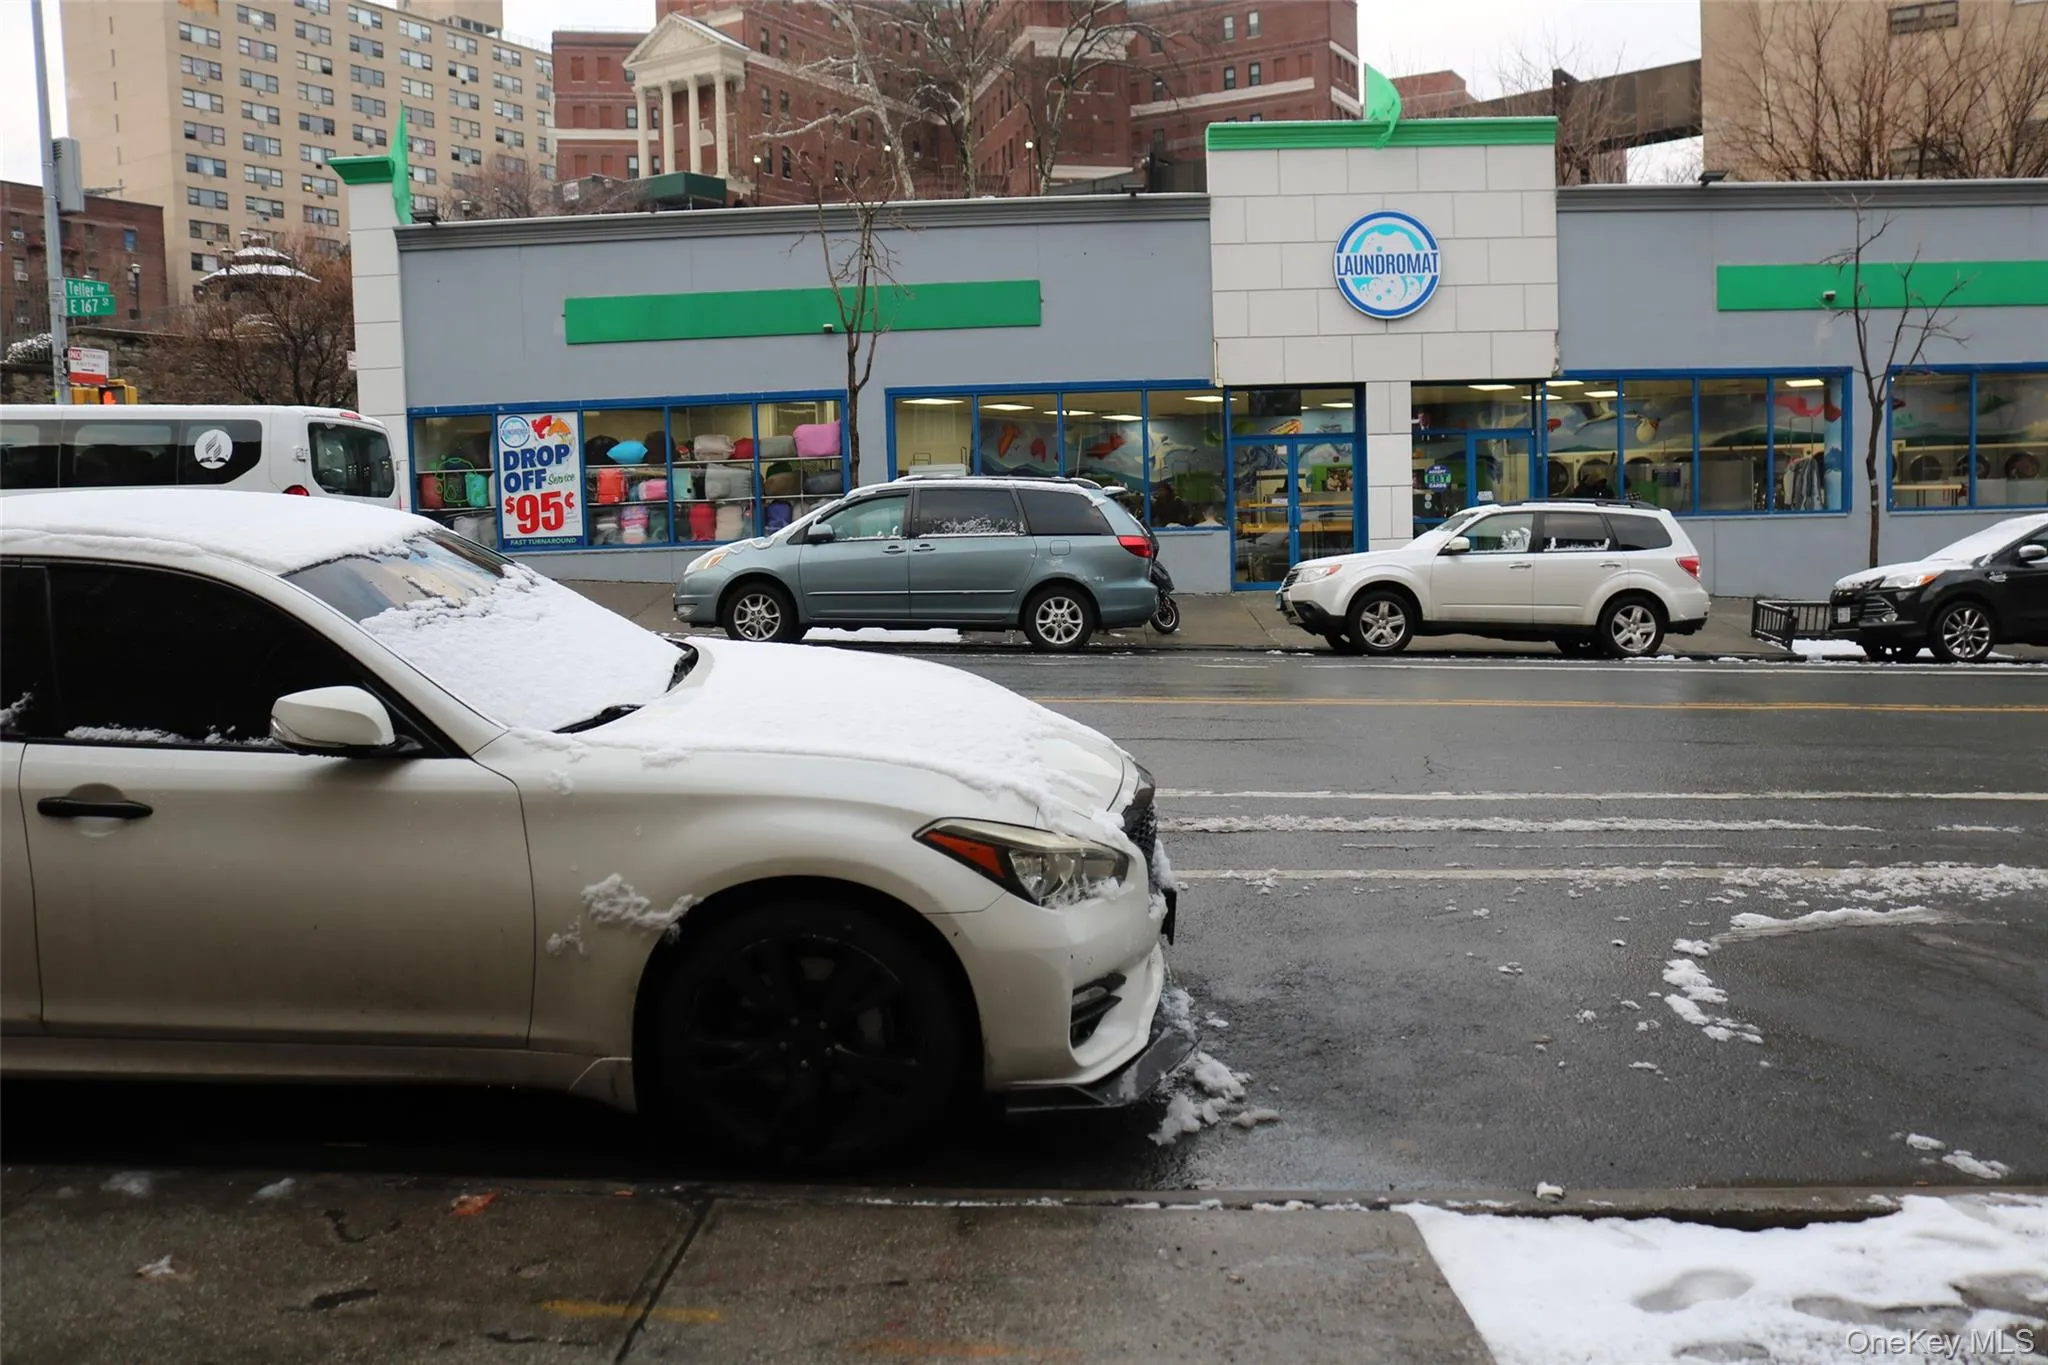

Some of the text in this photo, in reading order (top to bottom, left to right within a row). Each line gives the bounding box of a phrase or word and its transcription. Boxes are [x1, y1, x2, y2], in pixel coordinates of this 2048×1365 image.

[1336, 252, 1439, 276] LAUNDROMAT
[68, 281, 94, 297] Teller
[71, 299, 77, 314] E
[81, 298, 98, 313] 167
[70, 349, 81, 360] NO
[503, 443, 570, 471] DROP
[503, 468, 575, 493] OFF Service
[528, 537, 577, 545] TURNAROUND
